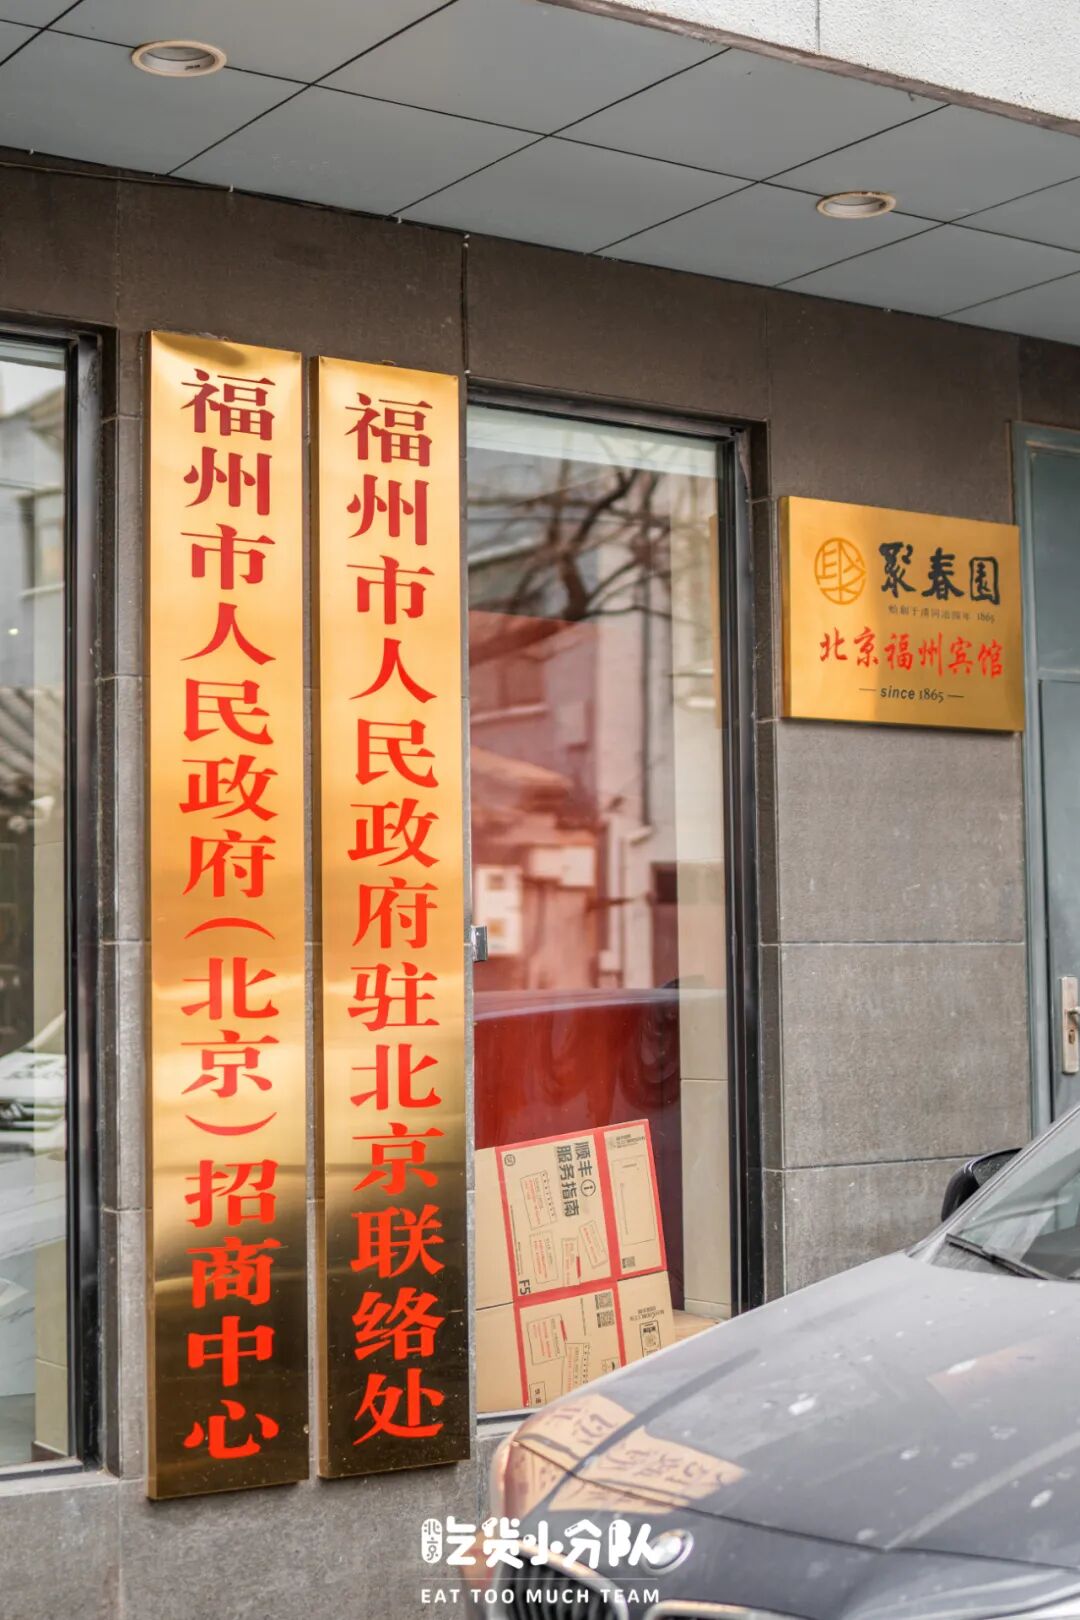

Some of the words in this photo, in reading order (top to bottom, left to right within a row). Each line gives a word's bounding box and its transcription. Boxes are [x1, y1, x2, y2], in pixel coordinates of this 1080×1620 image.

[819, 626, 1004, 679] 北京福州宾馆
[880, 685, 915, 700] since
[919, 688, 945, 704] 1865
[178, 367, 281, 1460] 福州市人民政府（北京）招商中心
[344, 391, 446, 1445] 福州市人民政府驻北京联络处
[556, 1145, 580, 1218] 服务指南
[573, 1140, 593, 1178] 顺丰
[517, 1279, 532, 1296] F5
